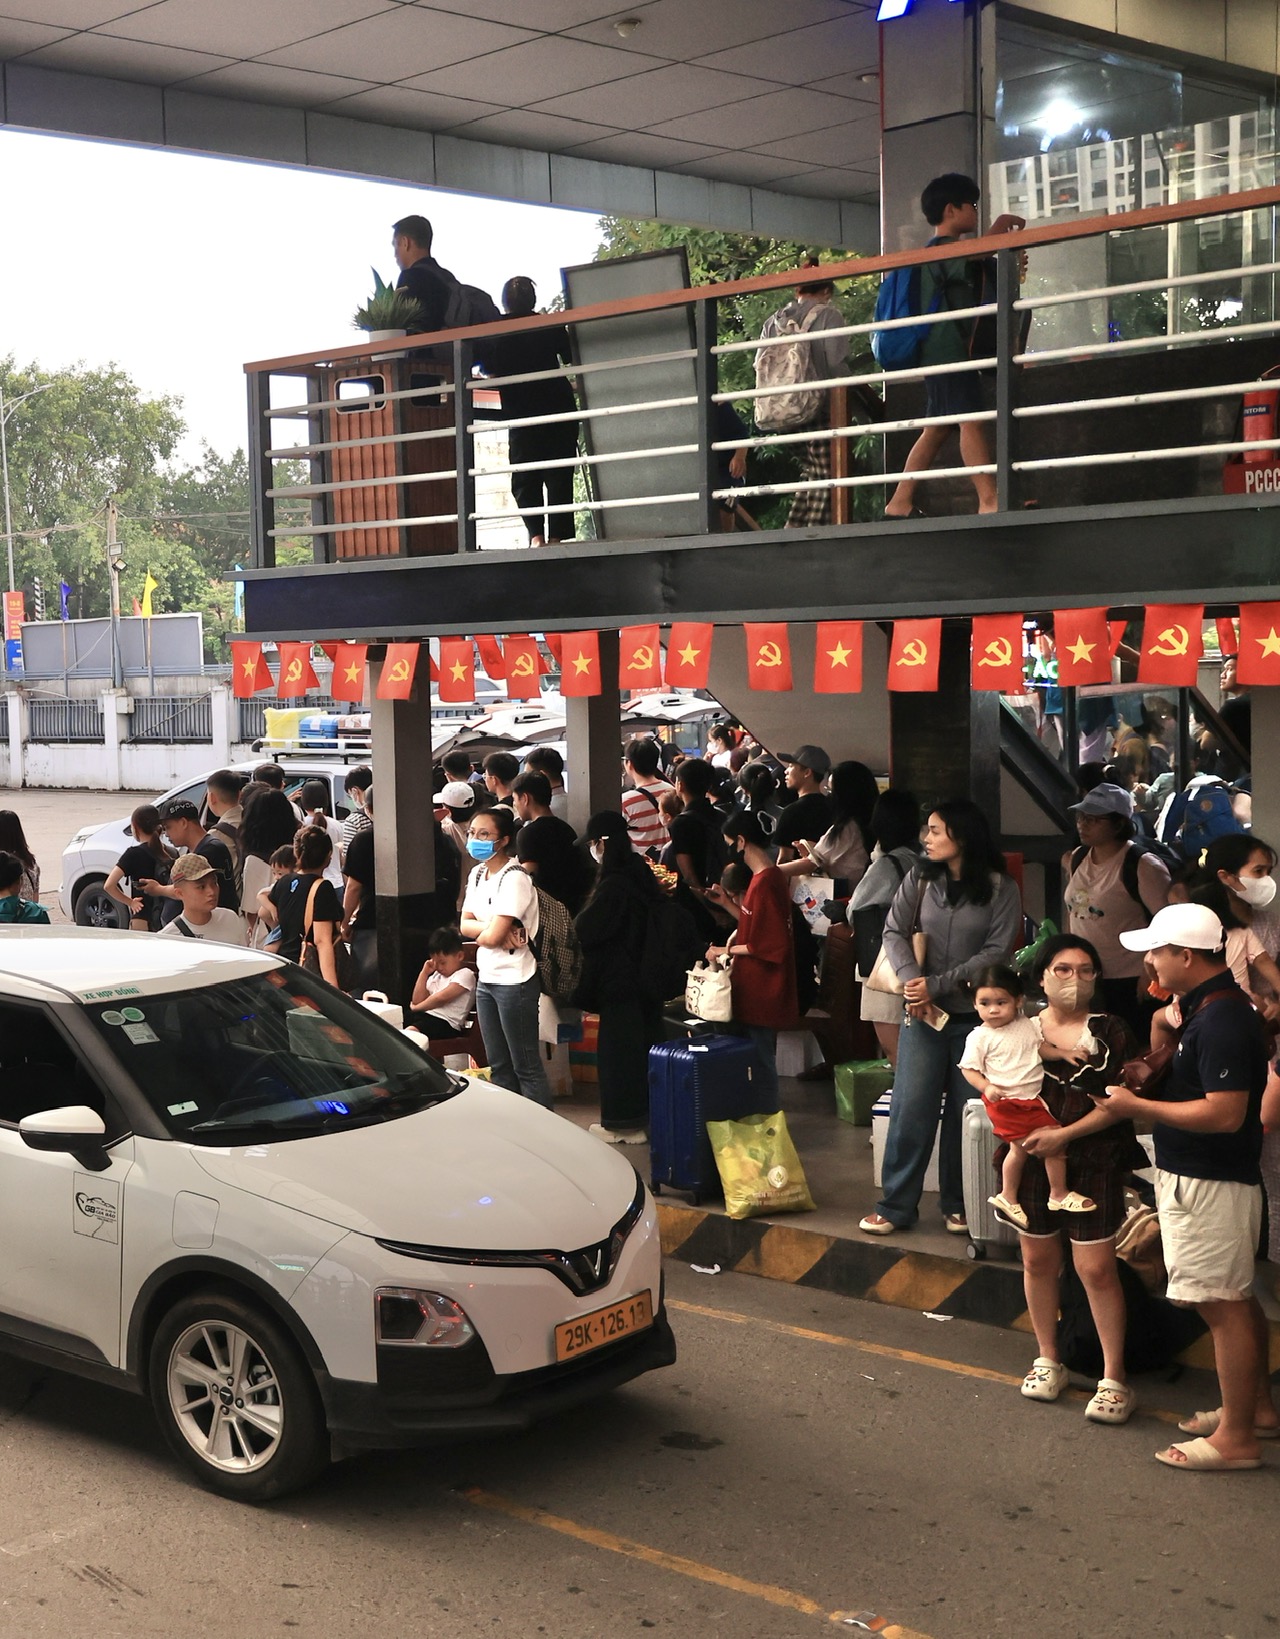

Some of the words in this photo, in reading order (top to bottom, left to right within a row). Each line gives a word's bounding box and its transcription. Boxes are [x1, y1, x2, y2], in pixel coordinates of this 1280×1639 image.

[1245, 467, 1280, 494] PCCC
[82, 992, 97, 1000] XE
[96, 989, 114, 999] HỢP
[84, 1204, 96, 1214] GB
